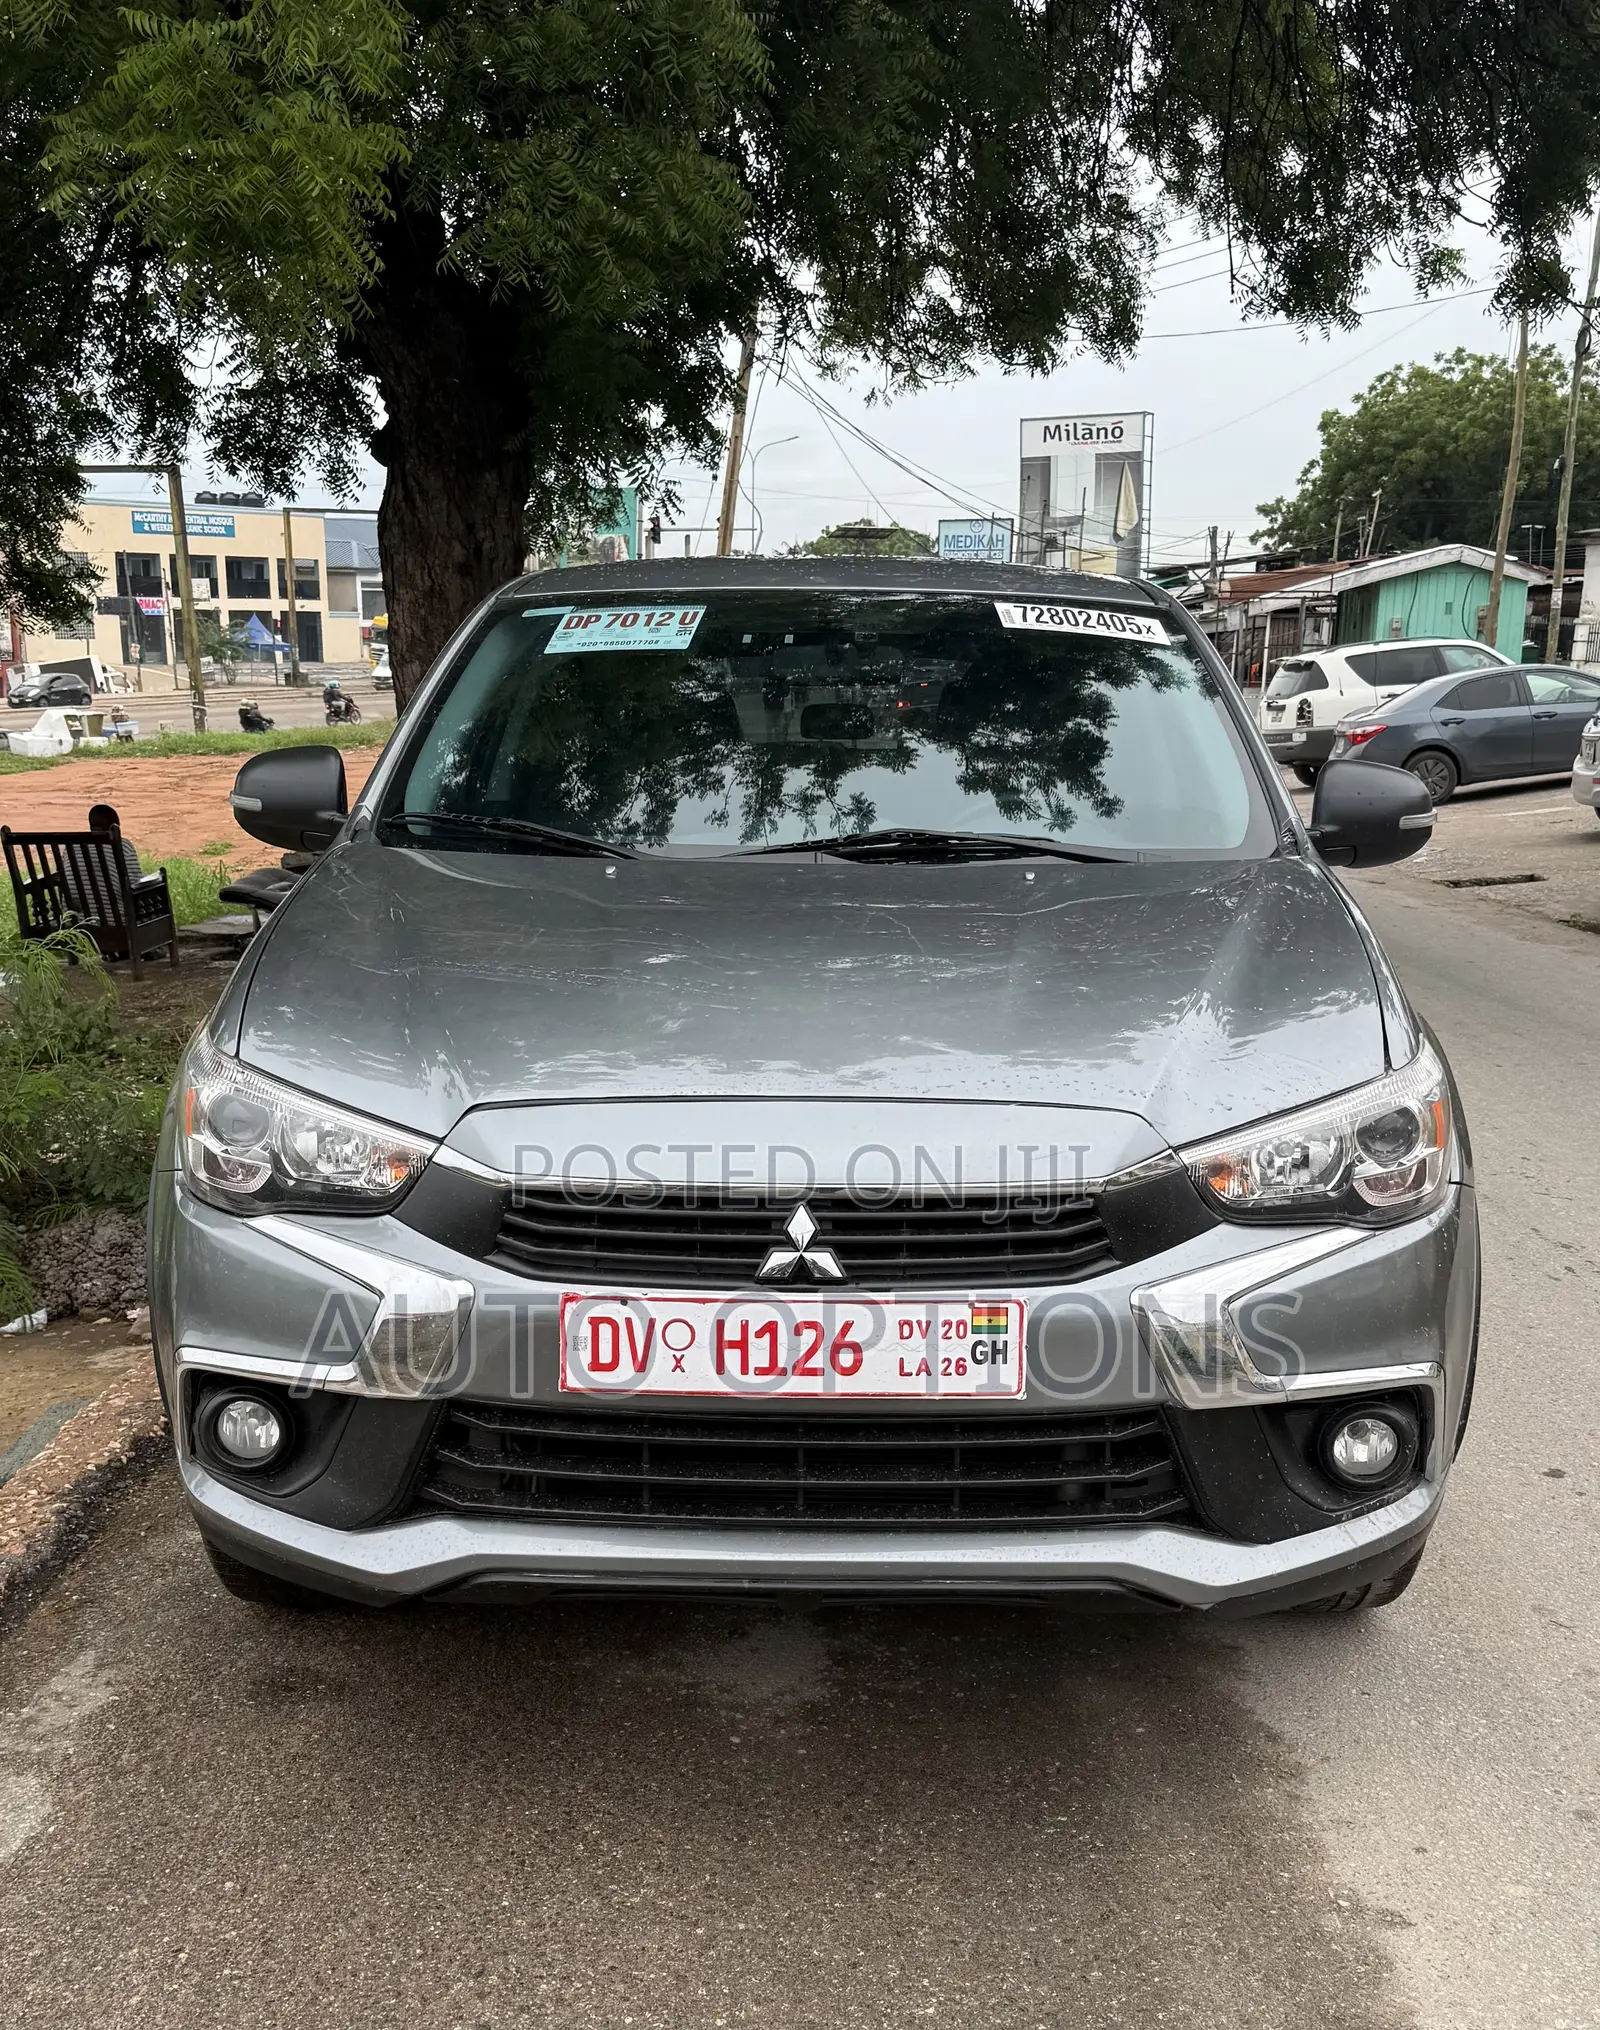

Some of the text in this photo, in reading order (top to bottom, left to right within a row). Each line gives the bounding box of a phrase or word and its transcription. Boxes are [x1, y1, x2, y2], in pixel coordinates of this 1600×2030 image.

[944, 534, 1005, 549] MEDIKAH
[563, 610, 700, 630] DP 7012 U
[899, 1319, 968, 1340] DV 20
[587, 1316, 656, 1373] DV
[716, 1318, 864, 1377] H126
[970, 1340, 1009, 1365] GH
[899, 1356, 968, 1377] LA 26
